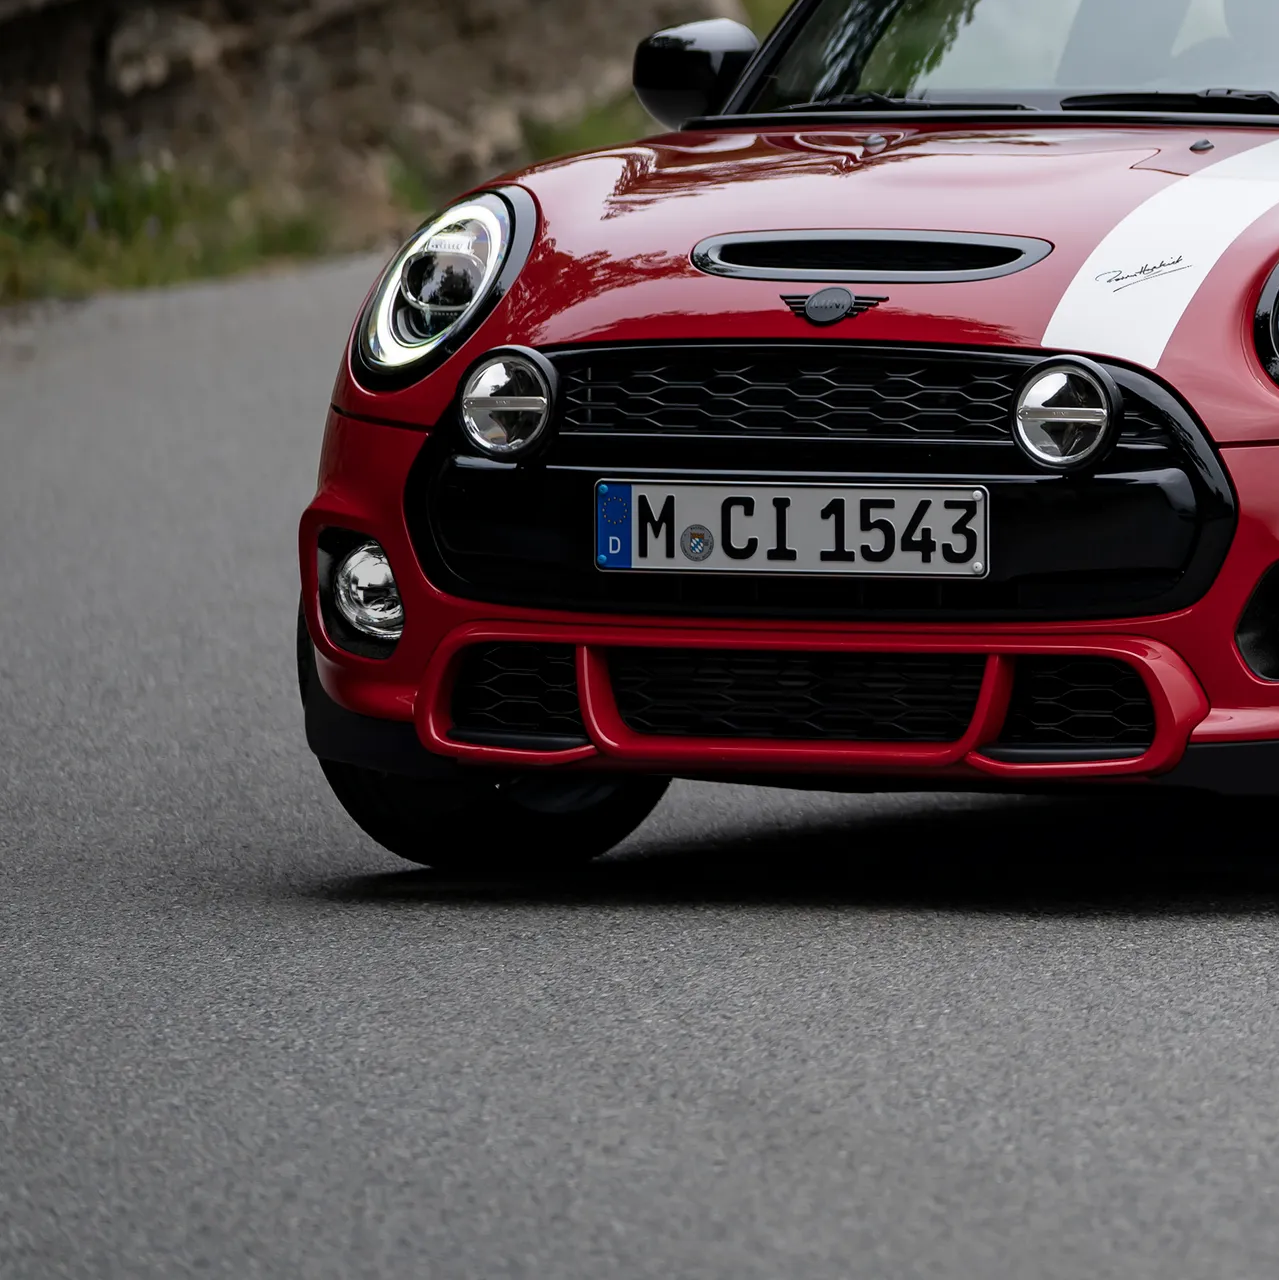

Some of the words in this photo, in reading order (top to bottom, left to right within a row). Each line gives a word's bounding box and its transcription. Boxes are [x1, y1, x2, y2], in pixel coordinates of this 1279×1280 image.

[608, 536, 621, 555] D
[638, 493, 676, 559] M
[721, 496, 798, 561] CI
[820, 497, 979, 564] 1543
